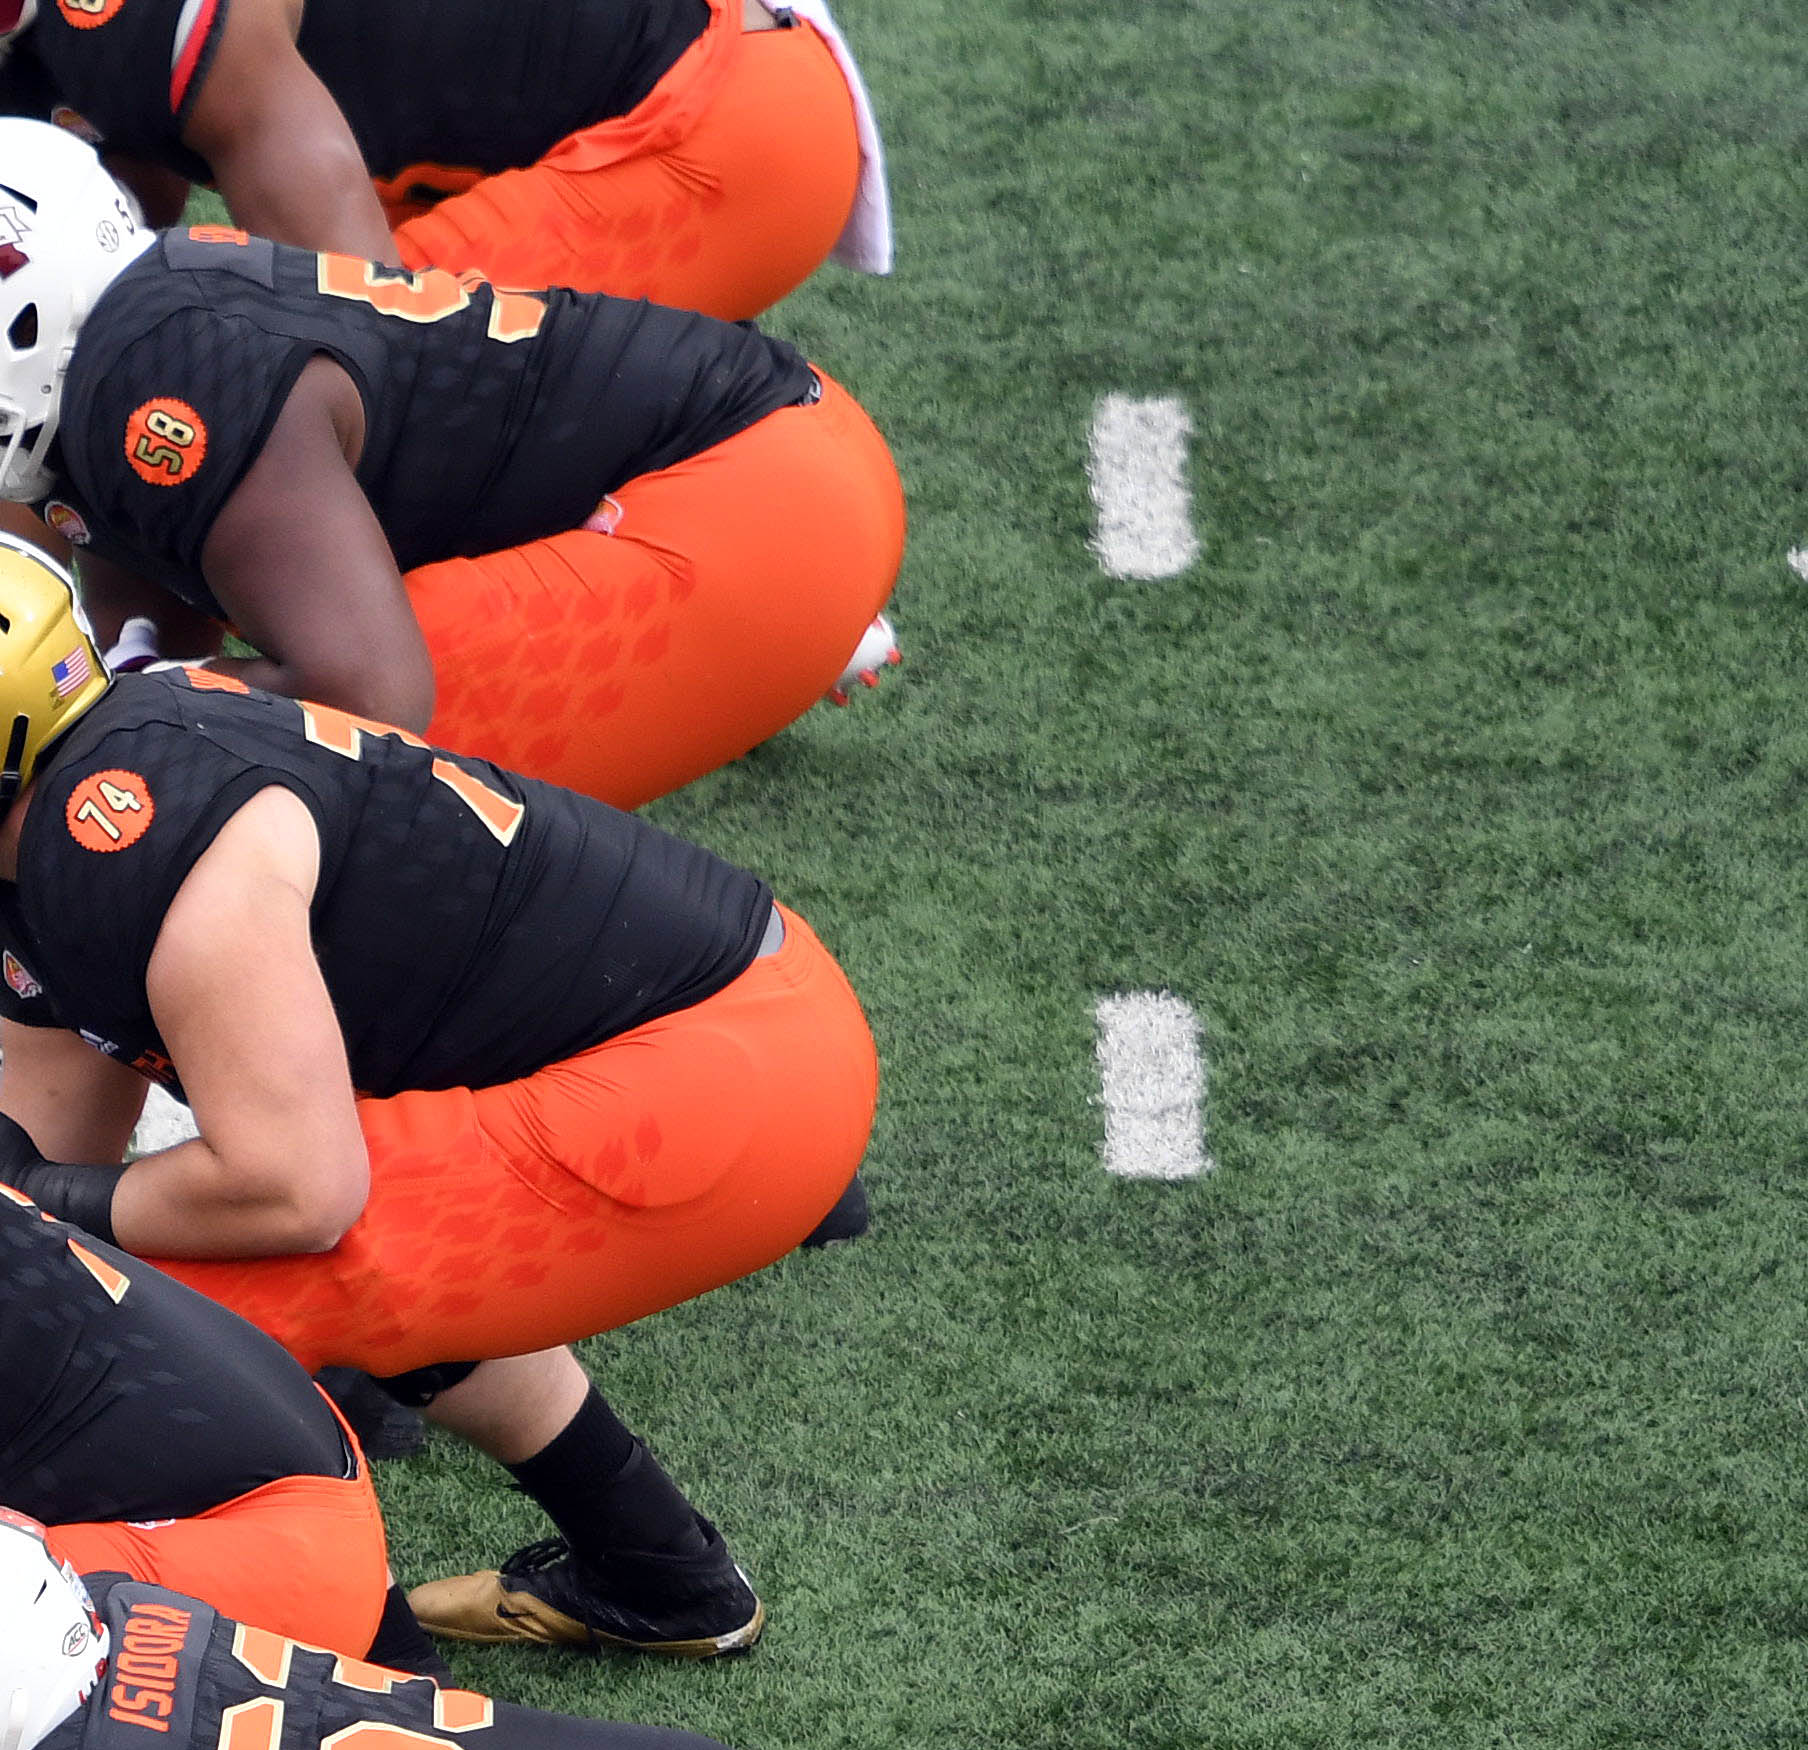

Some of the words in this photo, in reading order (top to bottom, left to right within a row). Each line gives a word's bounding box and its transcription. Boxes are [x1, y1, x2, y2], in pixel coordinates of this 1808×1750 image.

[135, 410, 196, 476] 58
[76, 780, 142, 842] 74
[108, 1602, 193, 1733] ISIDORA
